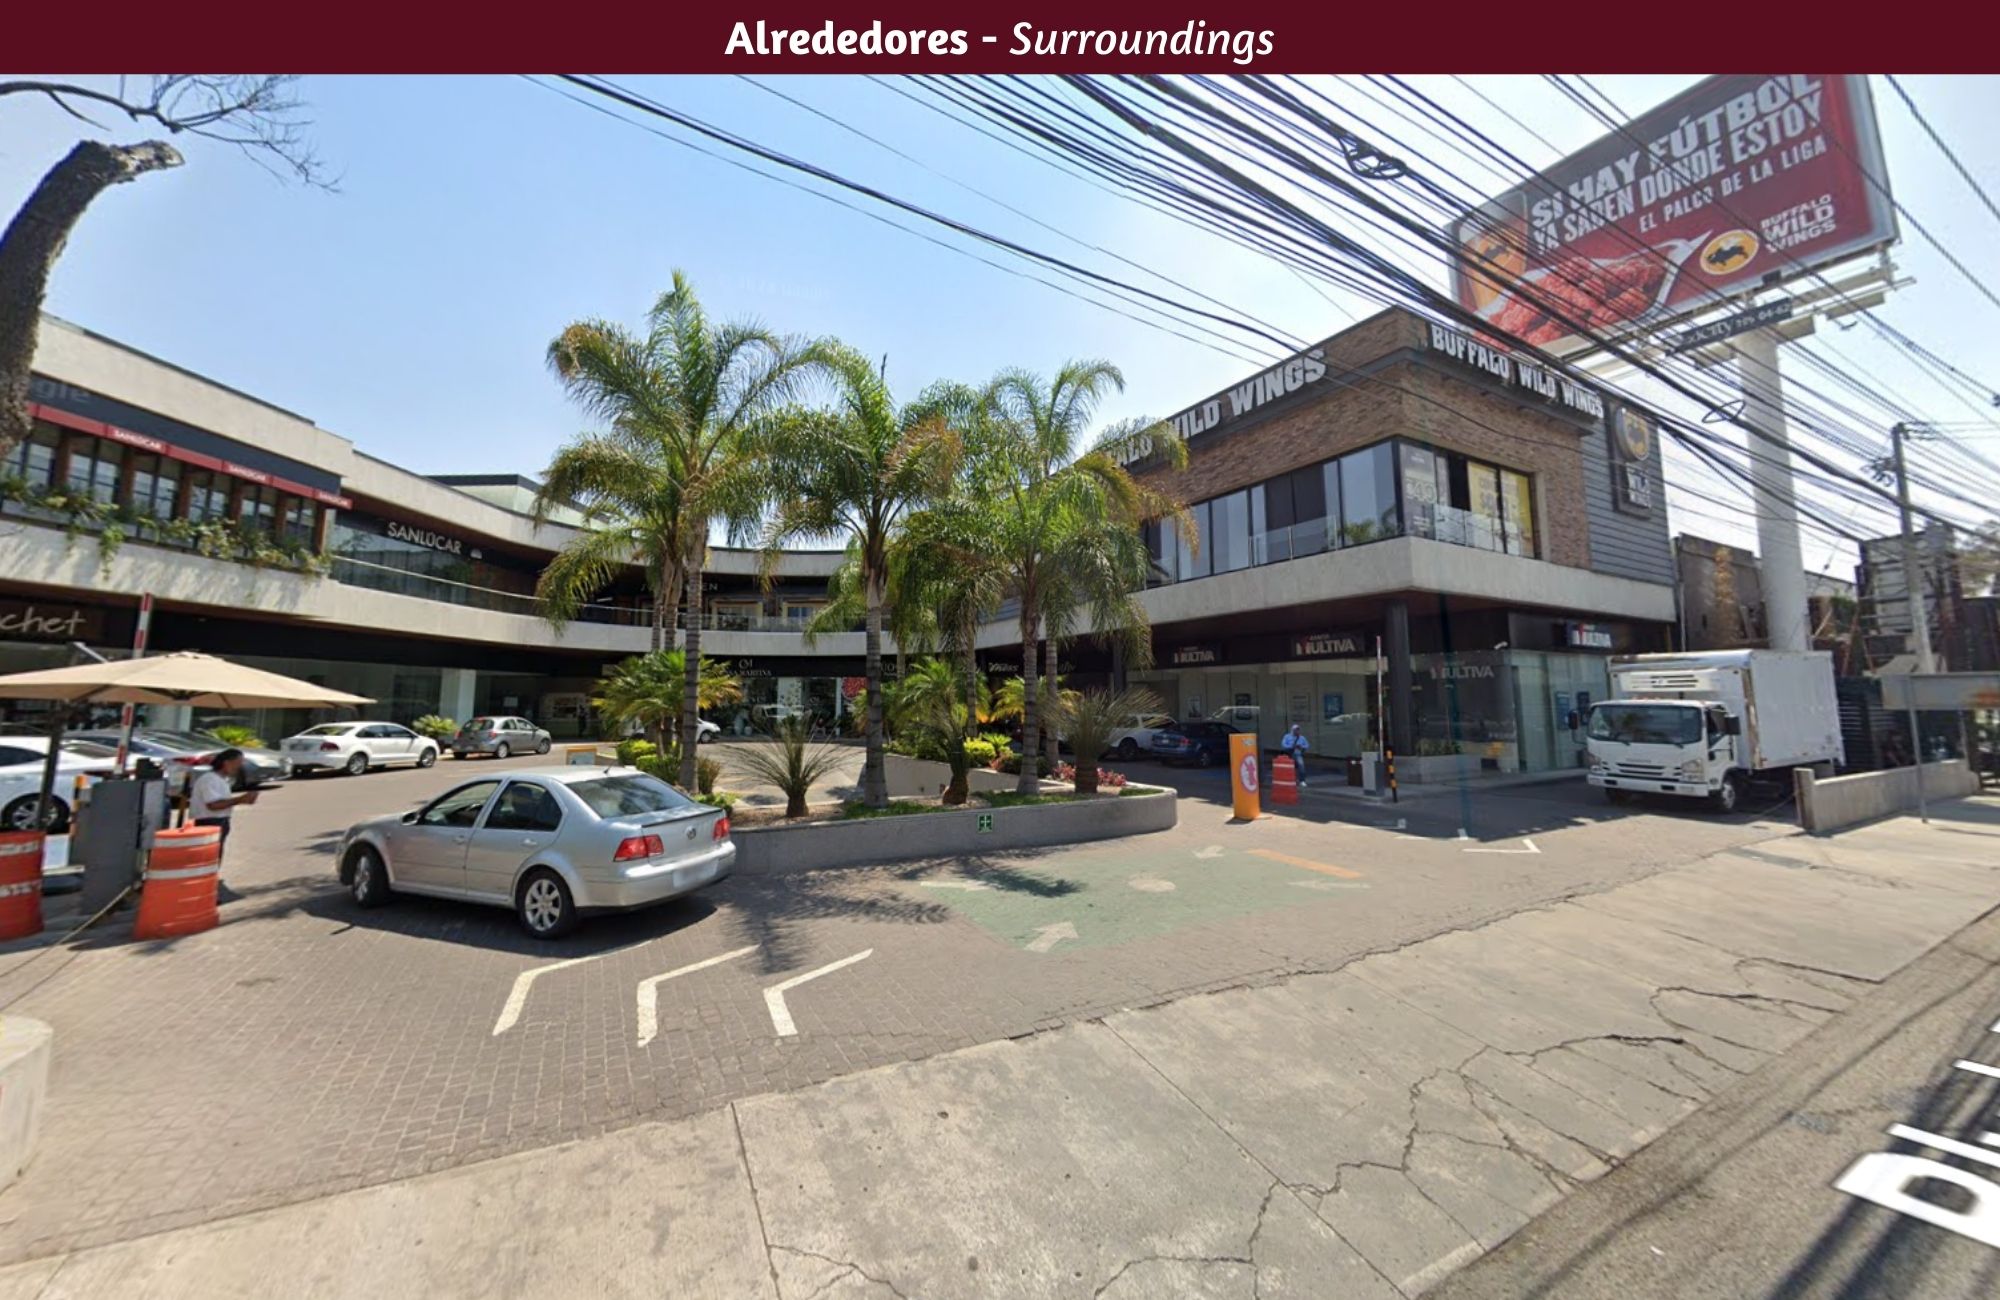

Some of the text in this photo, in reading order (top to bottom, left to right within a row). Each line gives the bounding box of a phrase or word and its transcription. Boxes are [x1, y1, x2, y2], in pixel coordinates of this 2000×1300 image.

[1532, 75, 1822, 228] SI HAY FÚTBOL
[1731, 91, 1821, 164] ESTOY
[1640, 134, 1826, 233] EL PALCO DE LA LIGA
[1761, 194, 1832, 228] BUFFALO
[1763, 204, 1836, 242] WILD
[1765, 220, 1837, 253] WINGS
[1228, 349, 1327, 416] WINGS
[1431, 324, 1604, 419] BUFFALO WILD WINGS
